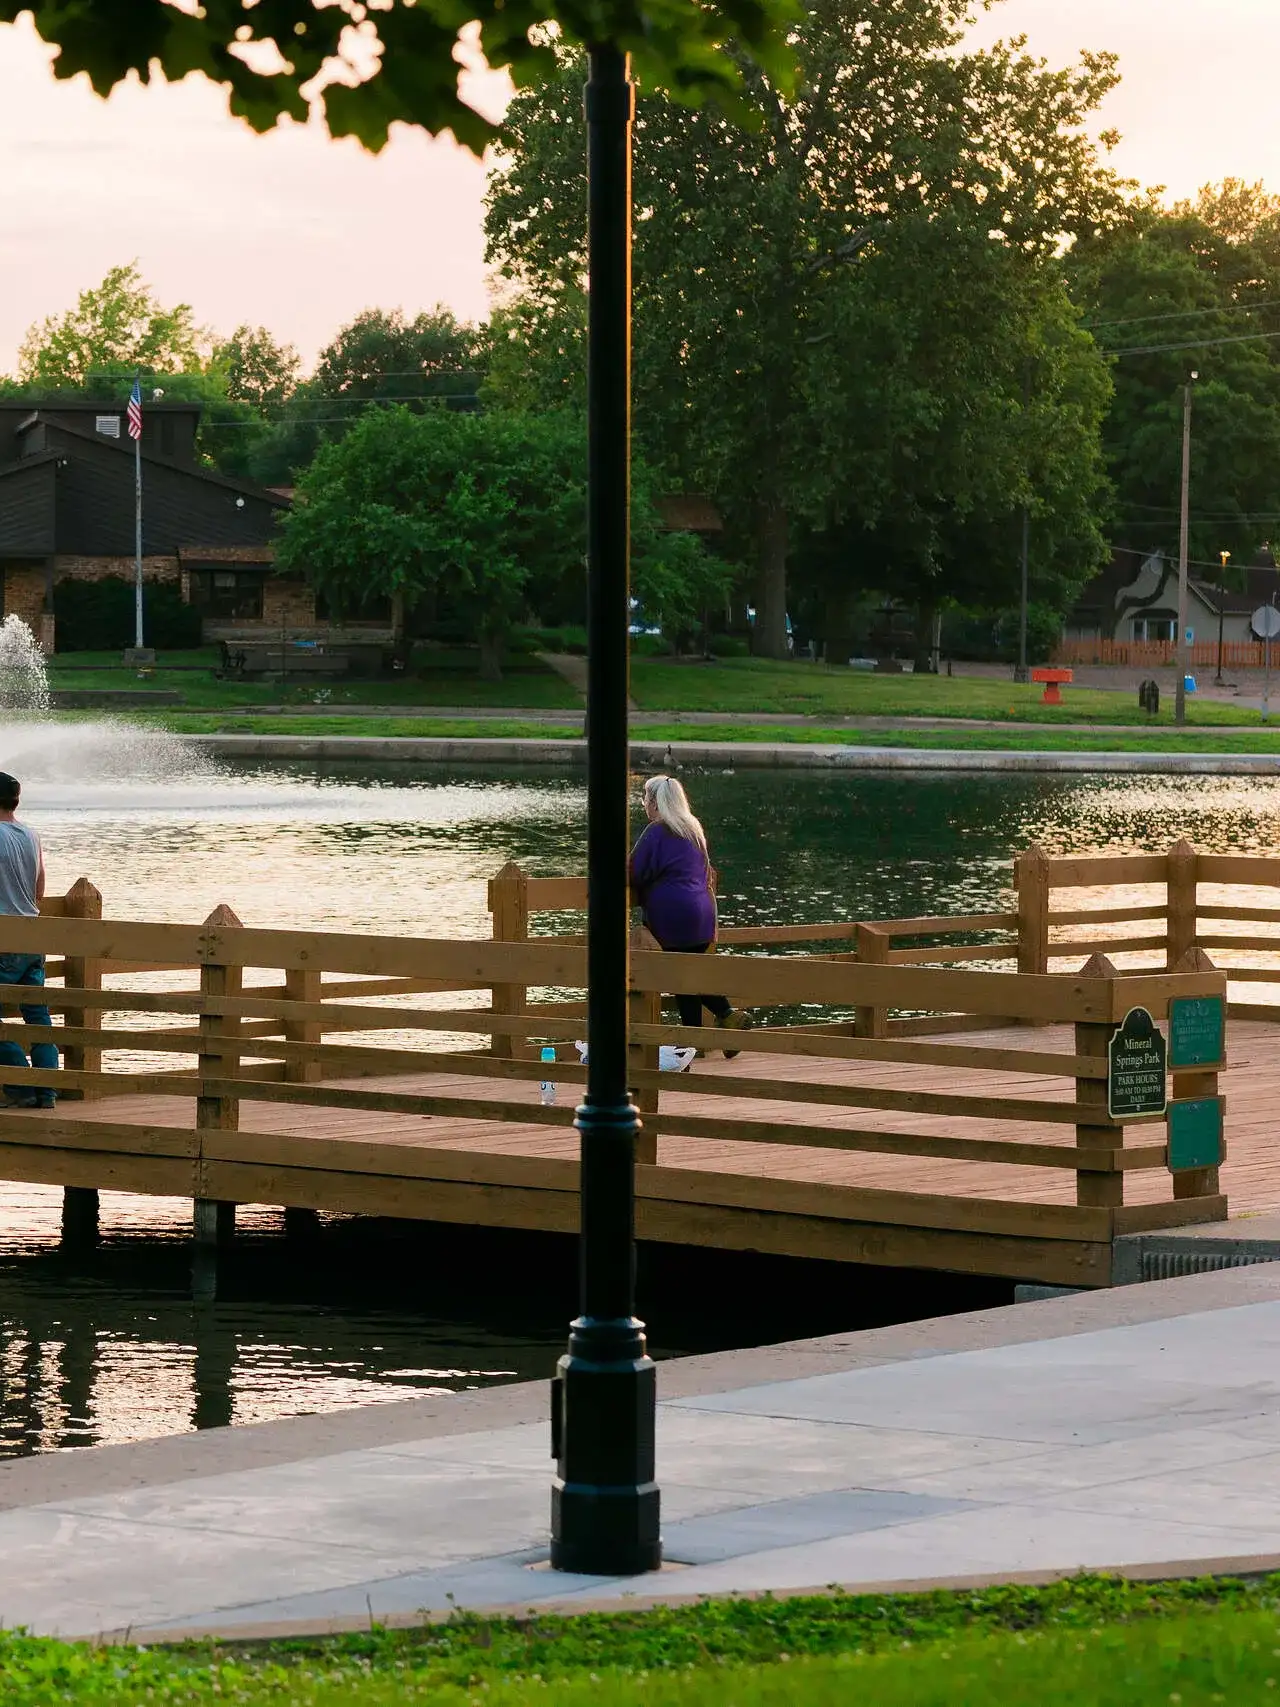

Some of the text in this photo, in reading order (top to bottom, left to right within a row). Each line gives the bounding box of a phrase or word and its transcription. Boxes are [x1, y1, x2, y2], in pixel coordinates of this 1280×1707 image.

[1124, 1036, 1152, 1050] Mineral
[1116, 1051, 1161, 1069] Springs Park
[1117, 1073, 1158, 1086] PARK HOURS
[1130, 1095, 1145, 1103] DAILY
